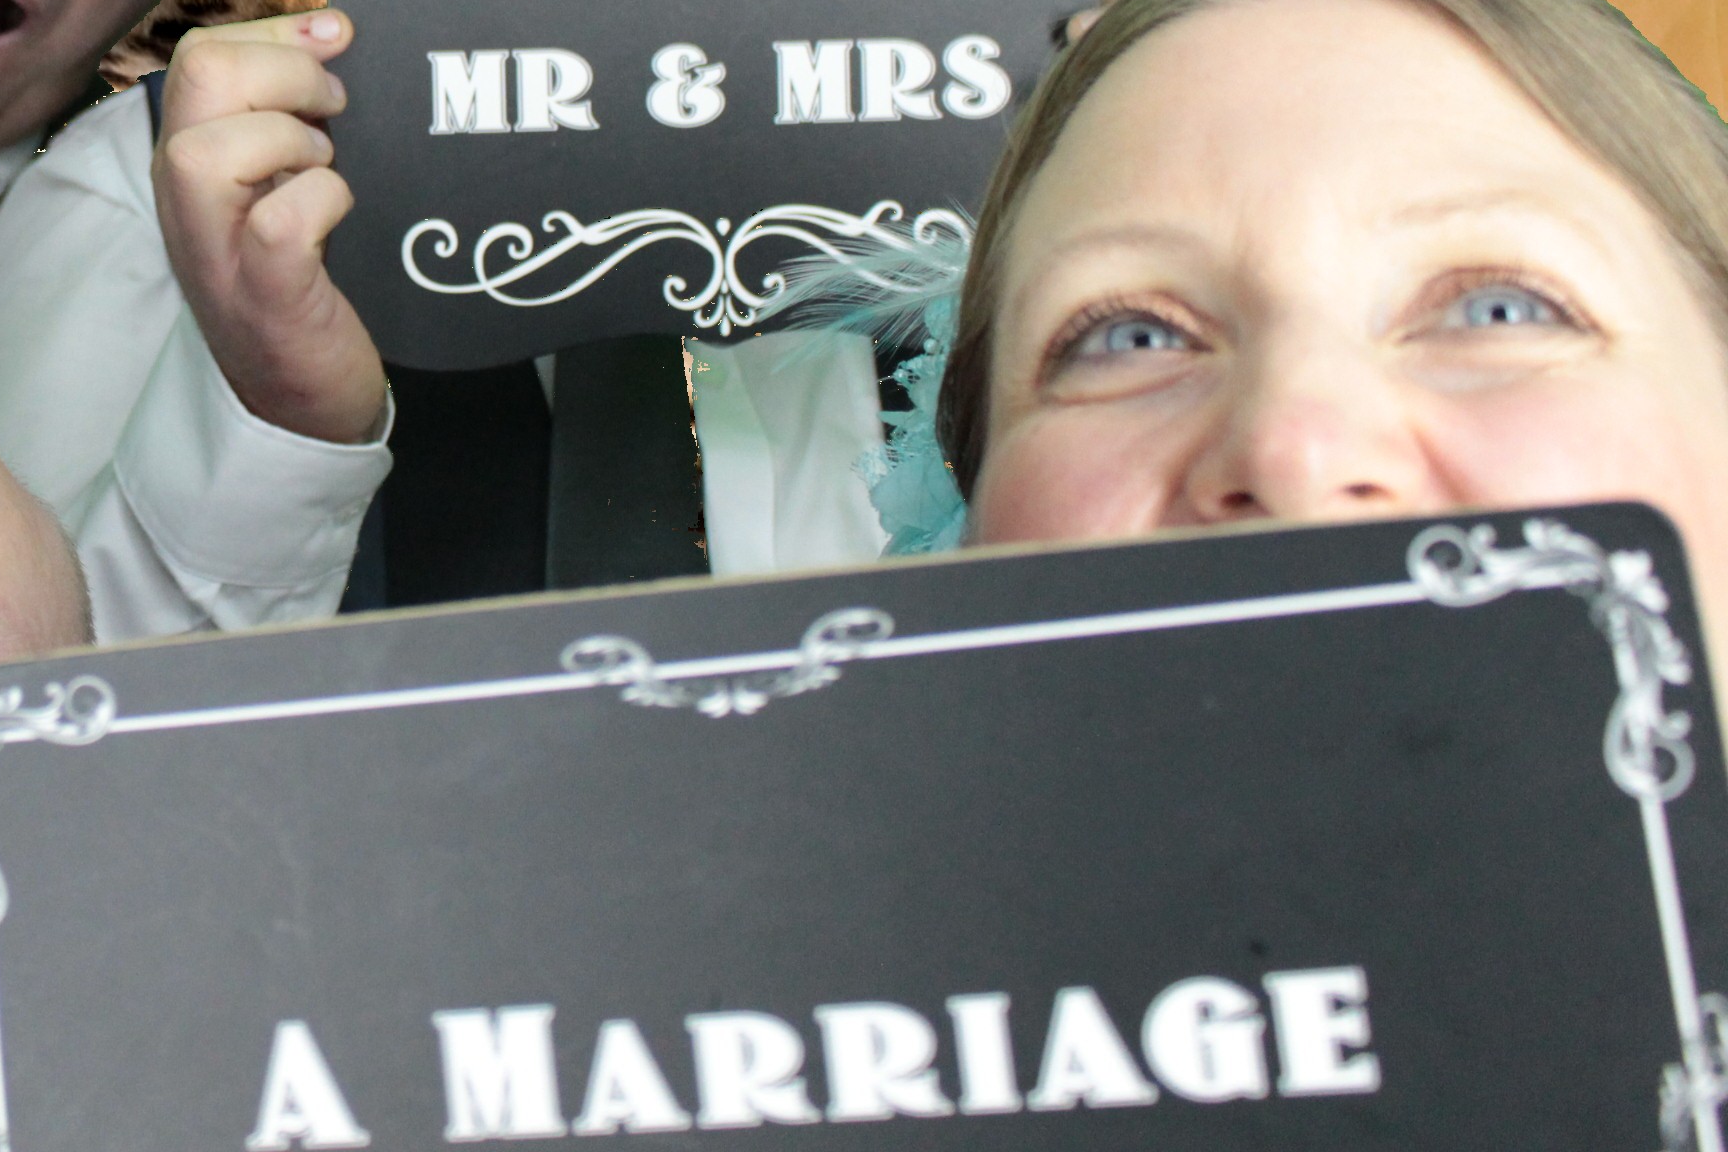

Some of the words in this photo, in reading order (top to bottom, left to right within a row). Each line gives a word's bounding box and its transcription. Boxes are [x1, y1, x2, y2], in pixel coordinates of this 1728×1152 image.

[427, 48, 600, 135] MR
[646, 43, 726, 128] &
[773, 34, 1012, 124] MRS
[246, 1018, 370, 1150] A
[432, 965, 1382, 1144] MARRIAGE
